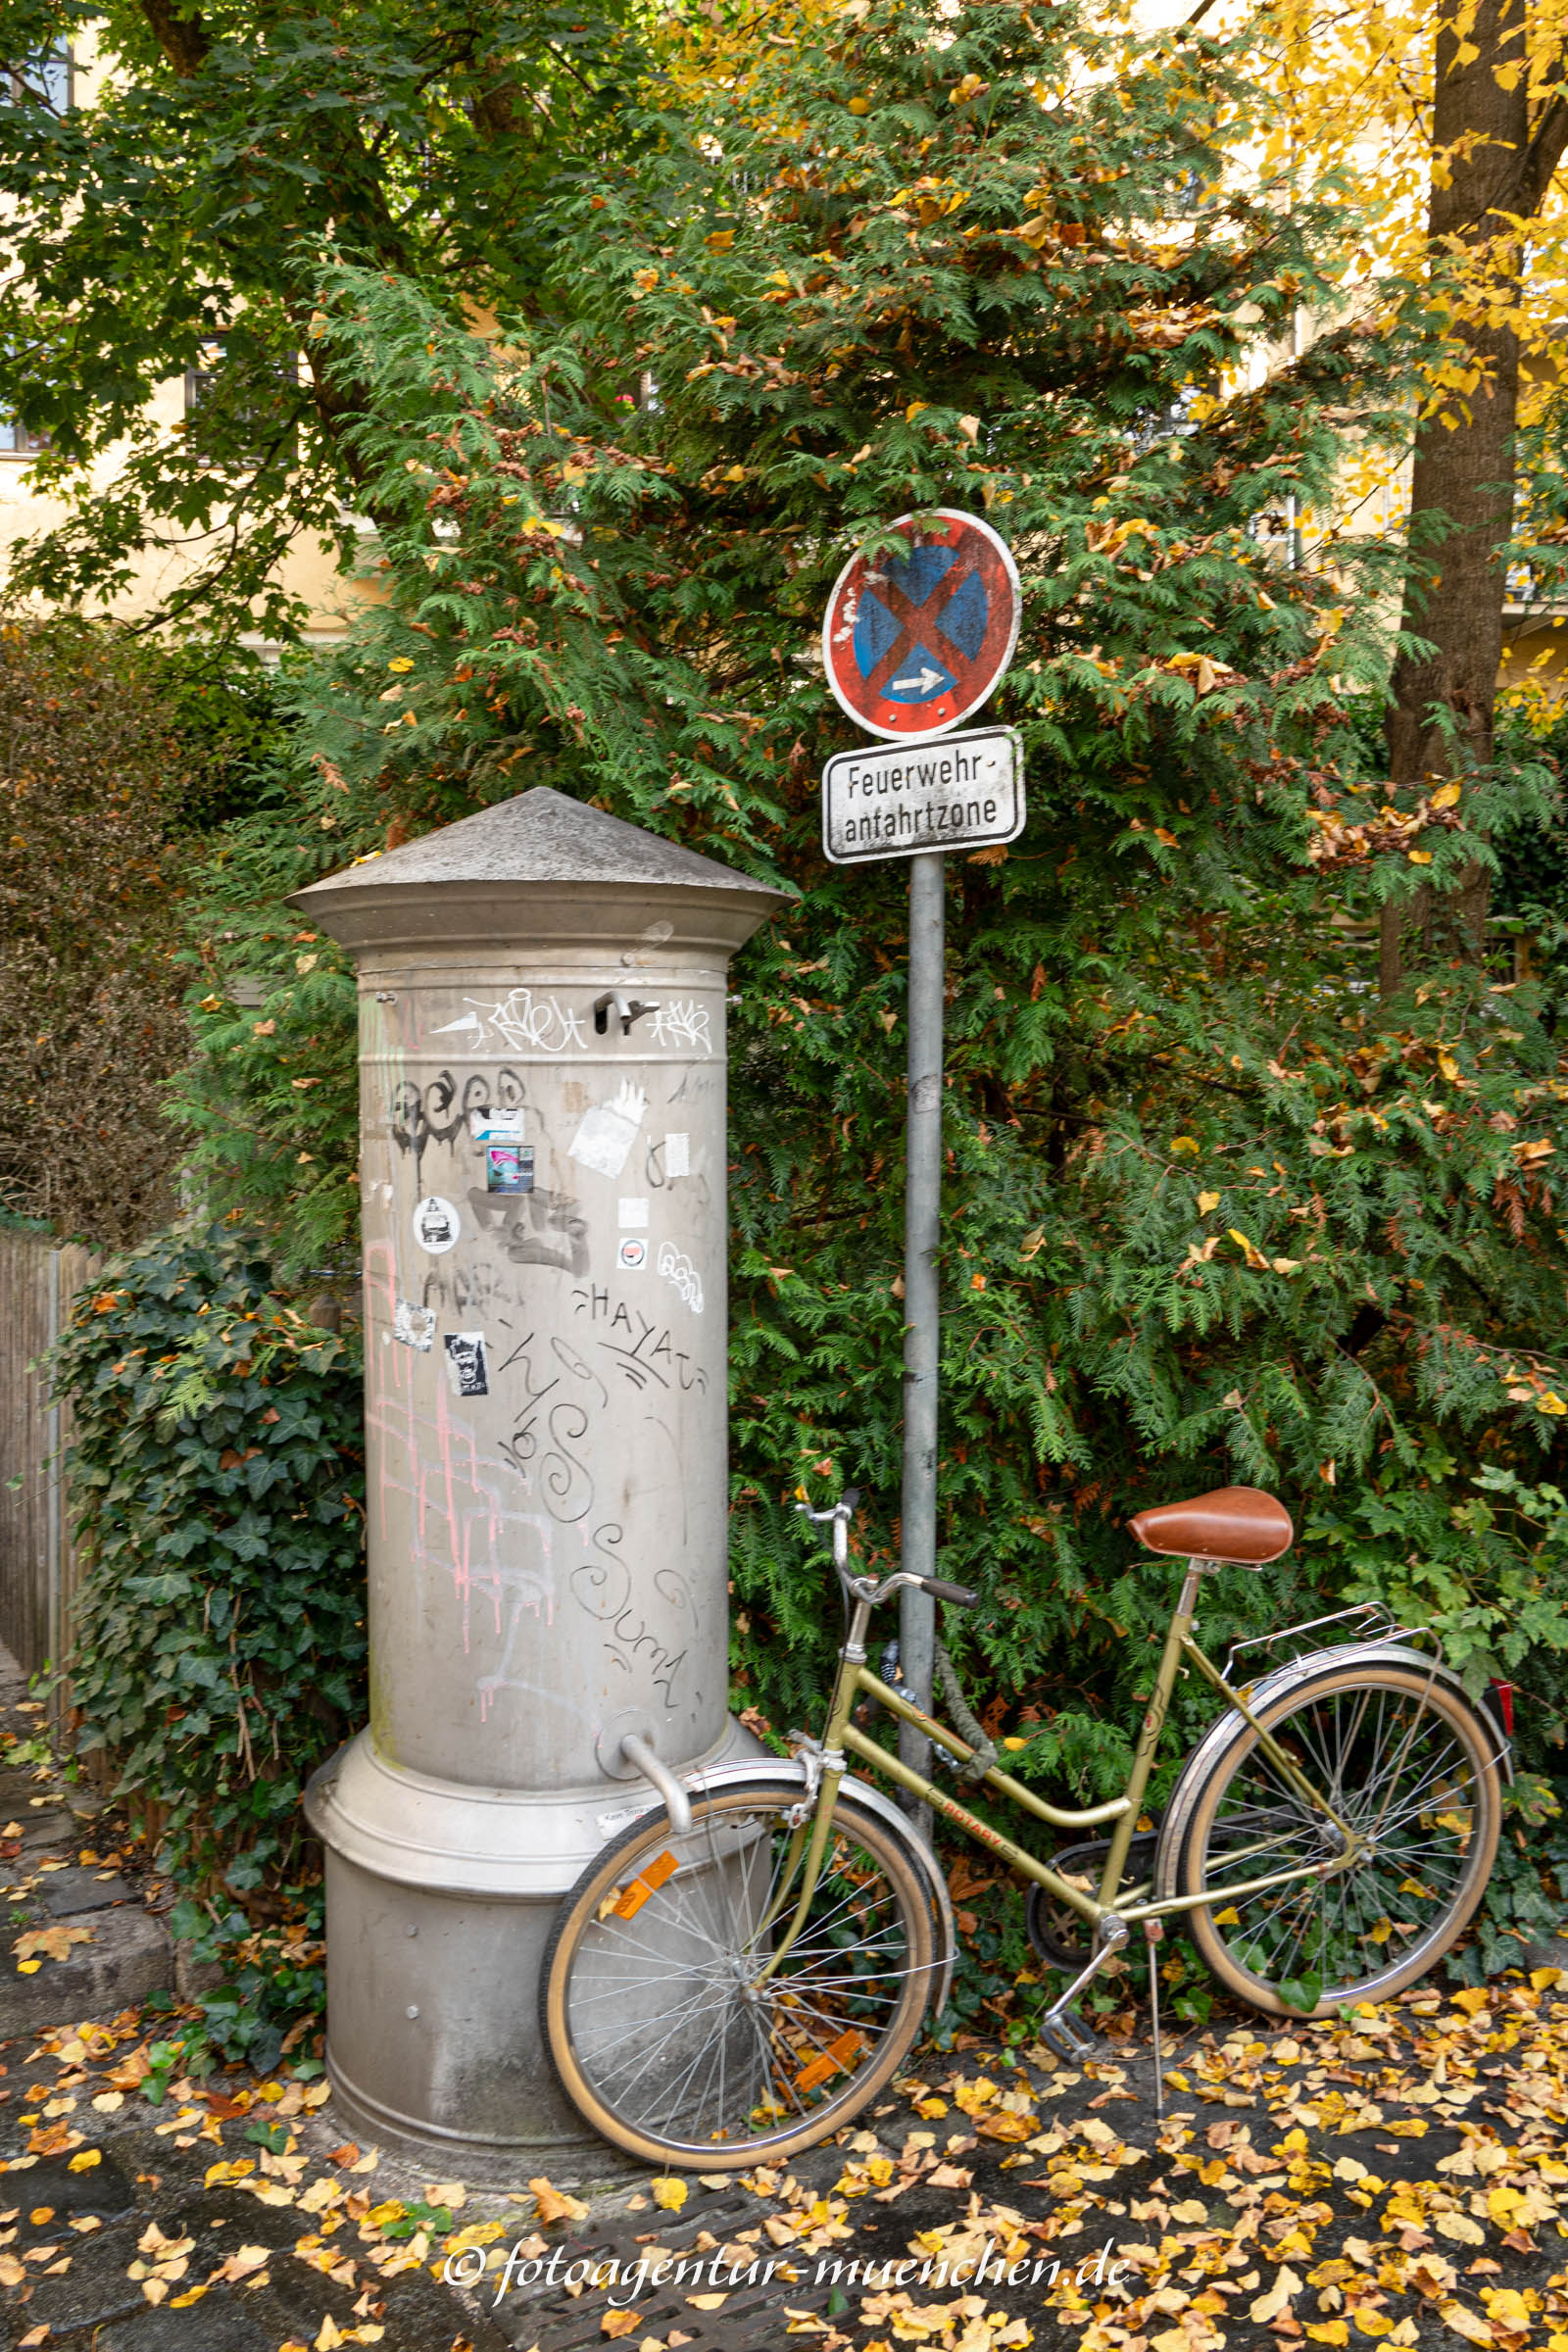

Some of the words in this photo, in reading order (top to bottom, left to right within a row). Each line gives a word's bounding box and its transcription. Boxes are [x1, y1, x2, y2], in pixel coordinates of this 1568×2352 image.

[847, 750, 996, 798] Feuerwehr-
[846, 799, 997, 843] anfahrtzone
[944, 1802, 1003, 1846] ROTARY
